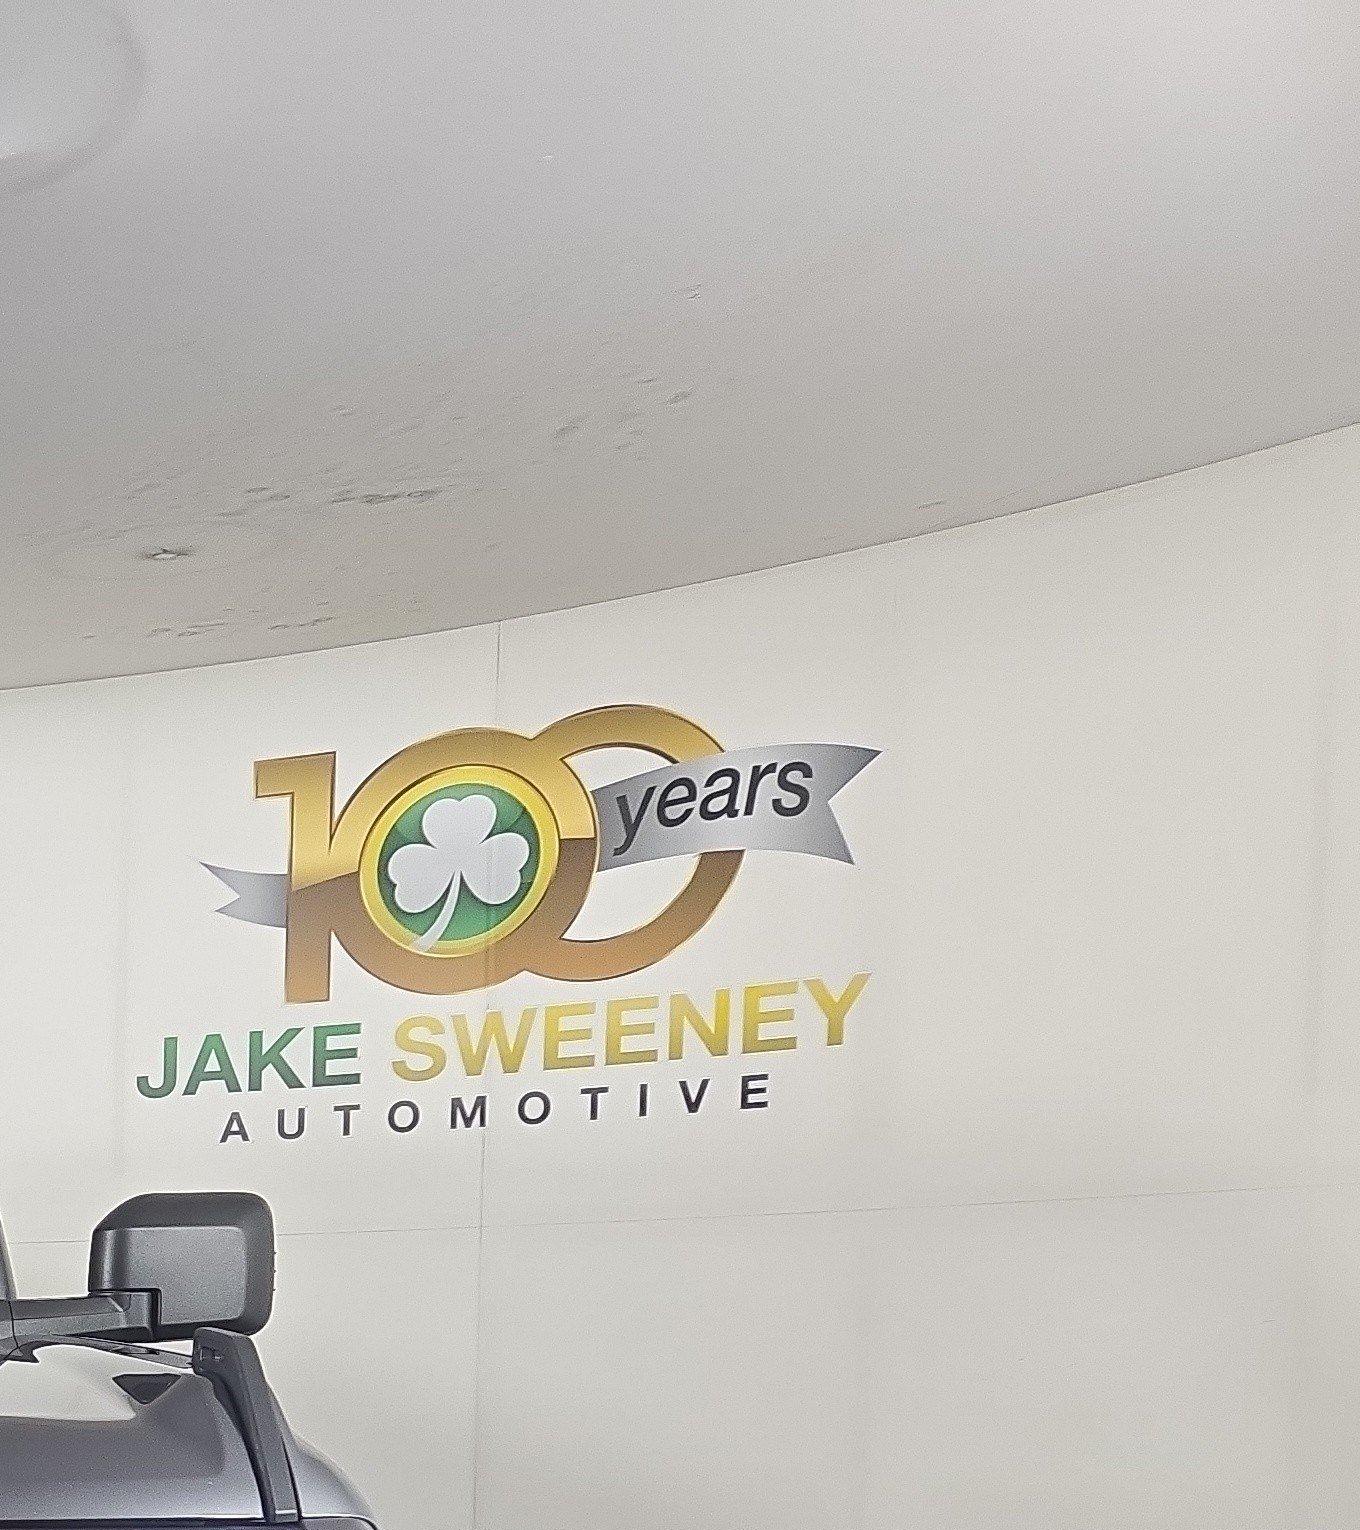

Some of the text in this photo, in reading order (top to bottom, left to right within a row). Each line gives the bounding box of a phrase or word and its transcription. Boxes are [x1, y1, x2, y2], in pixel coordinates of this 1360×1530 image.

[612, 755, 813, 857] years
[136, 971, 872, 1099] JAKE SWEENEY
[220, 1073, 770, 1143] AUTOMOTIVE
